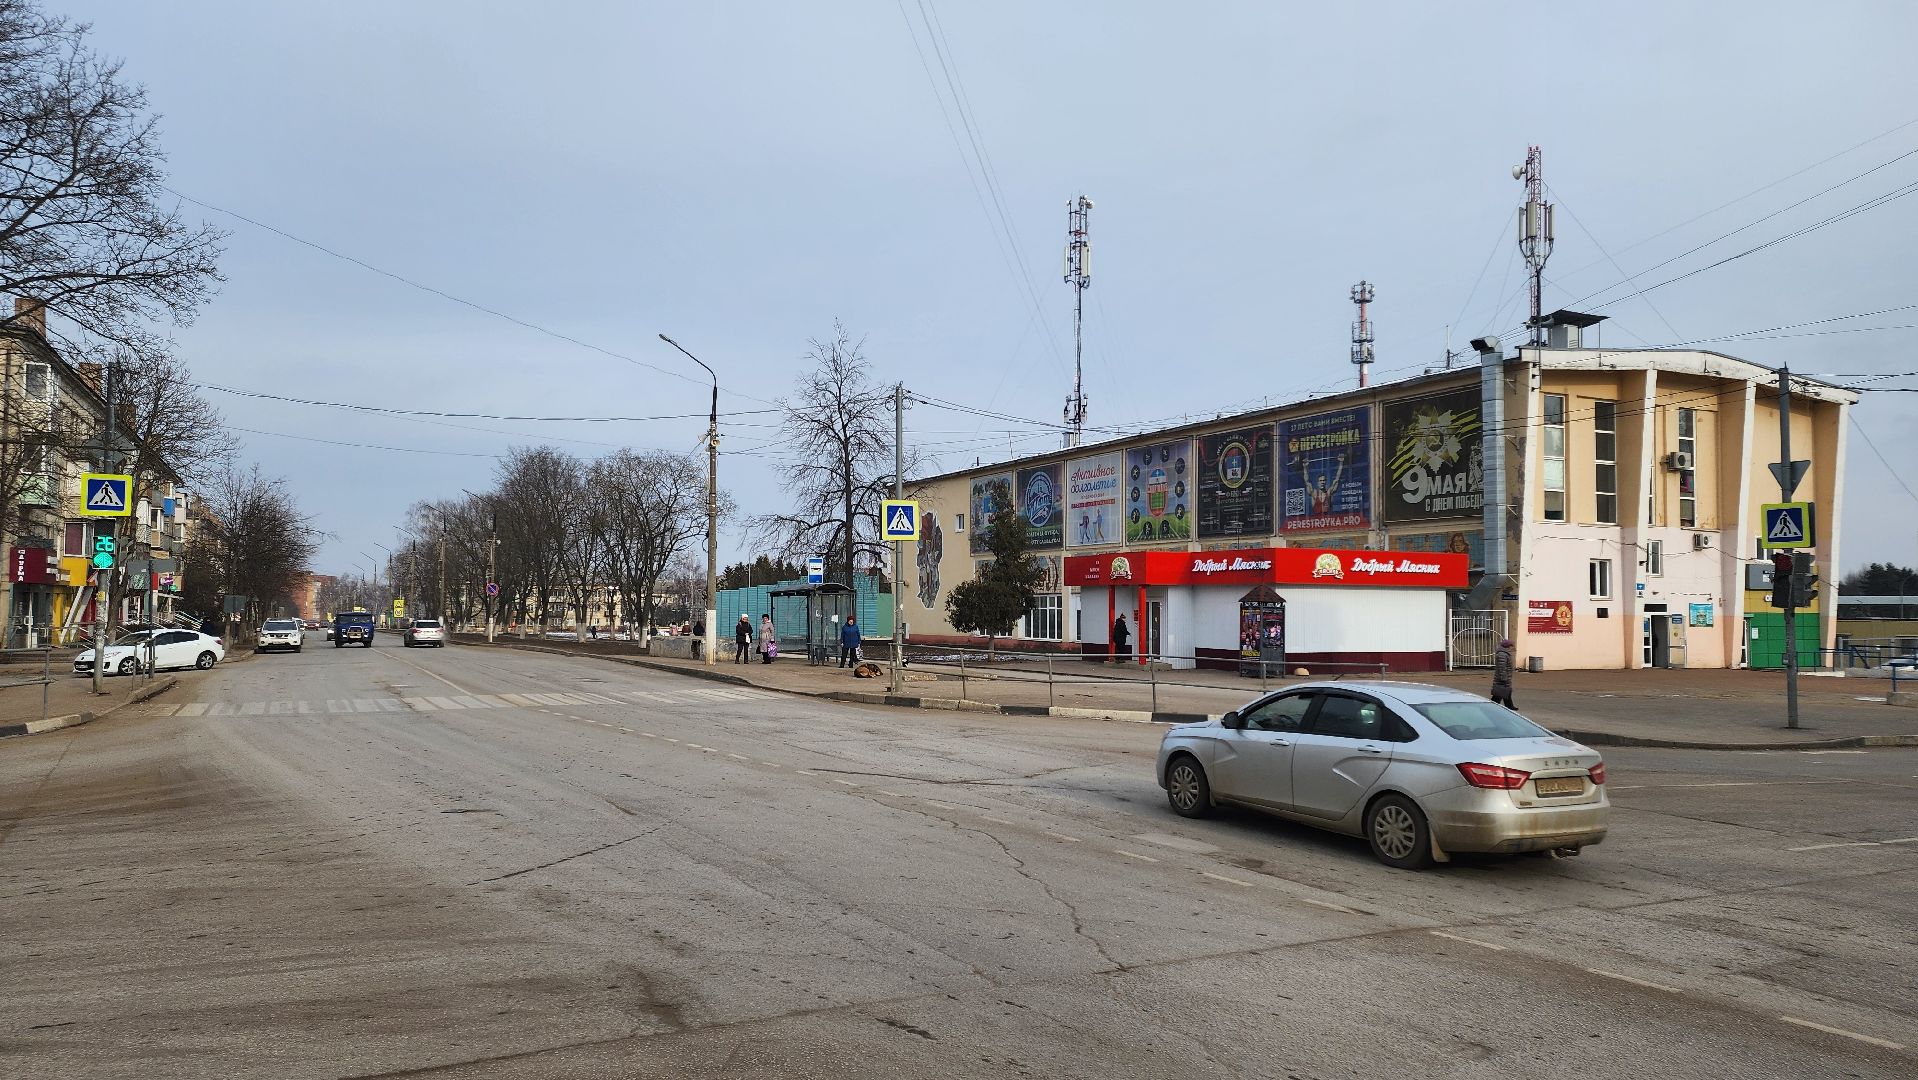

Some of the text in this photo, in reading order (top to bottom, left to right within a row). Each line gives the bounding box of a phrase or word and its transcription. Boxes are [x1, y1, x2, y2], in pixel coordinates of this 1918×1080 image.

[1300, 428, 1361, 452] ПЕРЕСТРОЙКА
[1071, 464, 1115, 483] Активное
[1071, 479, 1117, 494] долголетие
[1401, 465, 1467, 504] 9 МАЯ
[1425, 498, 1431, 512] С
[1287, 515, 1361, 529] PERESTROYKA.PRO
[96, 536, 114, 552] 26
[1192, 557, 1272, 575] Добрый Мясник
[1351, 557, 1394, 575] Добрый
[1395, 559, 1440, 574] Мясник
[1544, 759, 1579, 767] LADA
